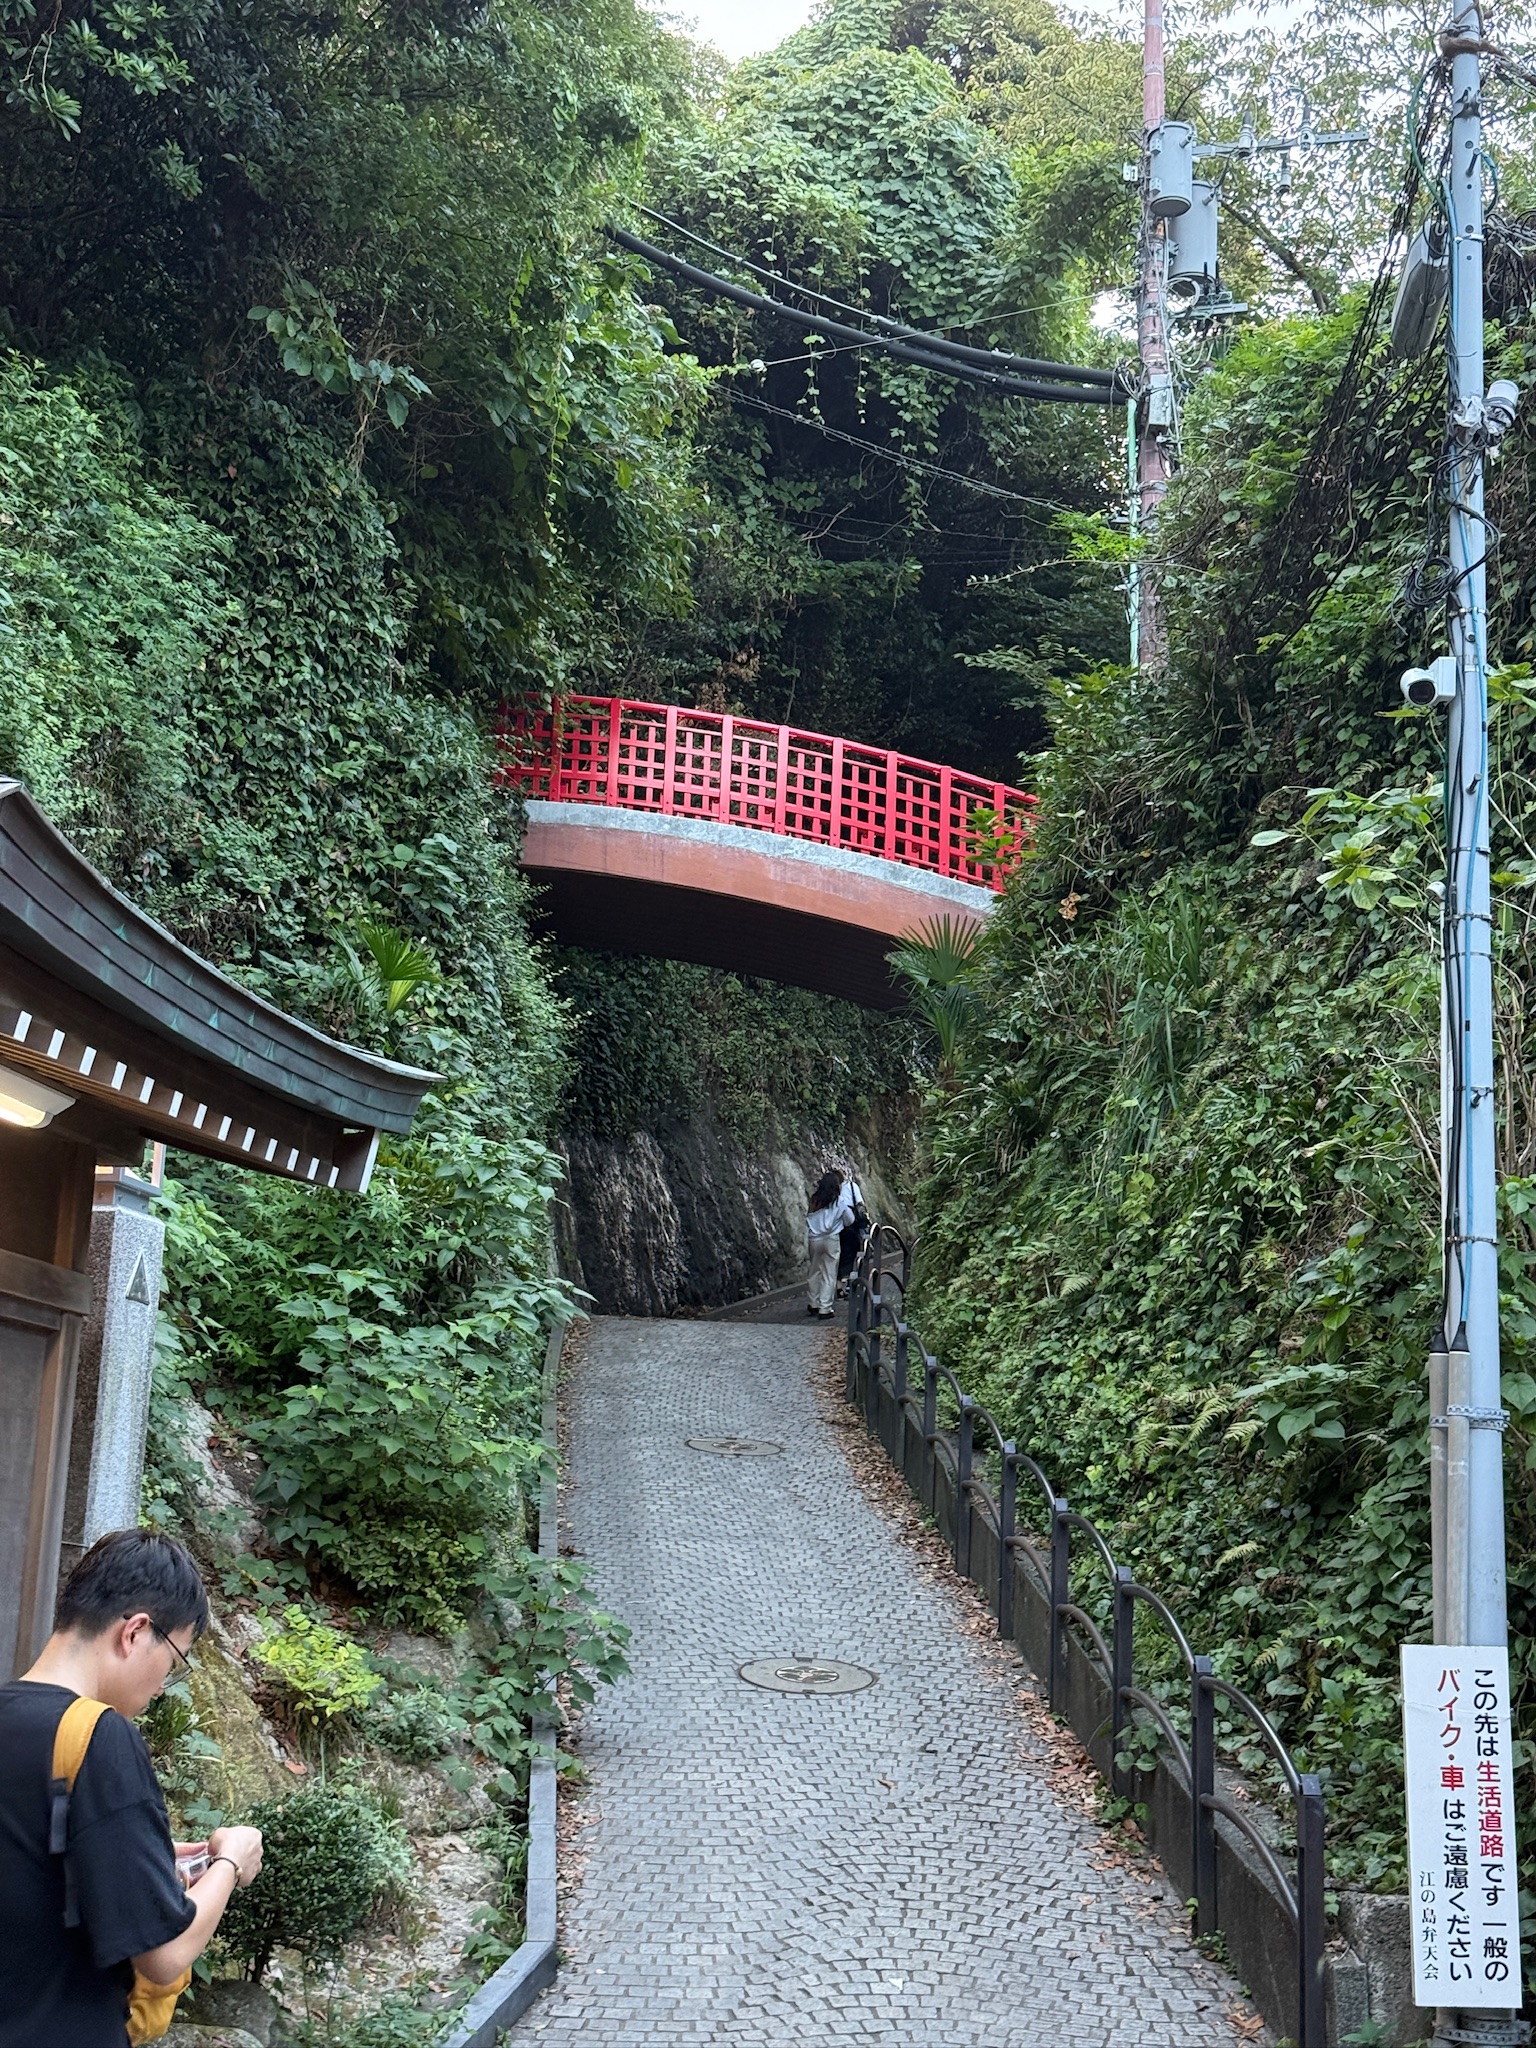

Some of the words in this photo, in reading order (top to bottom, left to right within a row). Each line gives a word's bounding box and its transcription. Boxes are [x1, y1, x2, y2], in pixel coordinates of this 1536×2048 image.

[1419, 1871, 1439, 1980] 江の島弁天会
